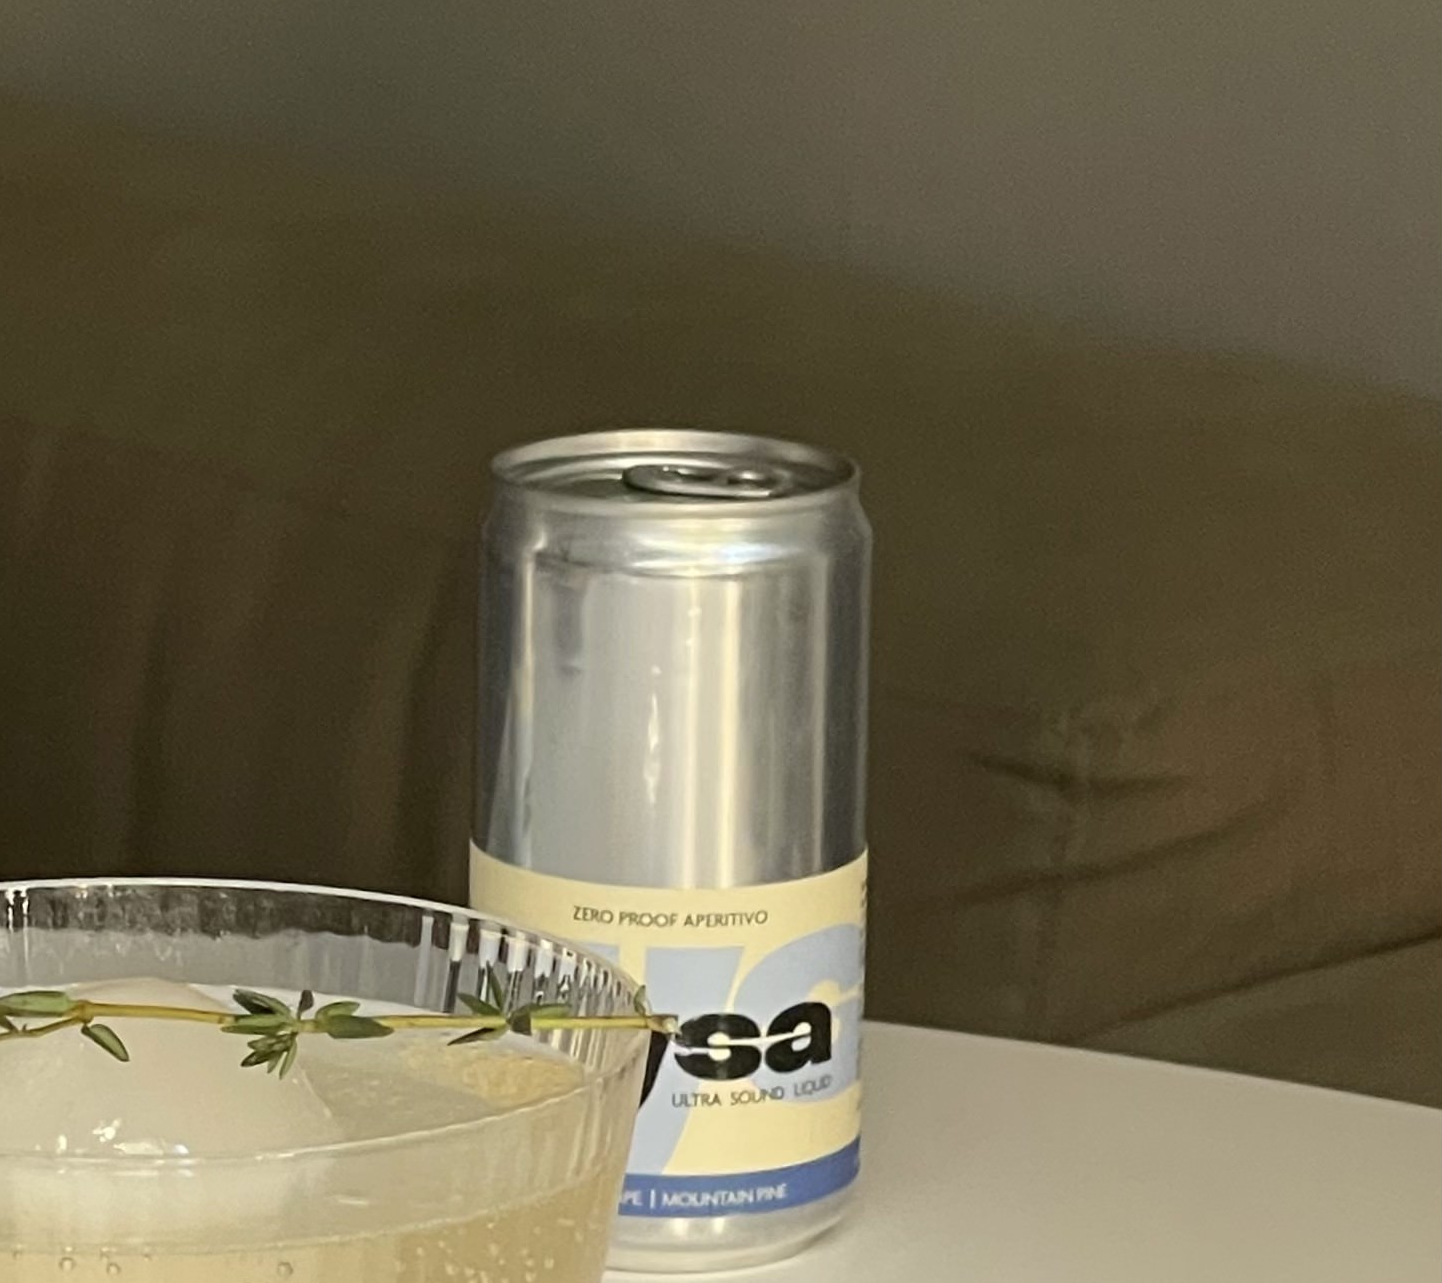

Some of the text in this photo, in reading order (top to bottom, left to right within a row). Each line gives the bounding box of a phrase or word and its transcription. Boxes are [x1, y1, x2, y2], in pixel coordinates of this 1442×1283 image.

[573, 905, 768, 927] ZERO PROOF APERITIVO
[671, 1074, 832, 1108] ULTRA SOUND LIQUID
[662, 1189, 753, 1207] MOUNTAIN
[756, 1183, 787, 1200] PINE
